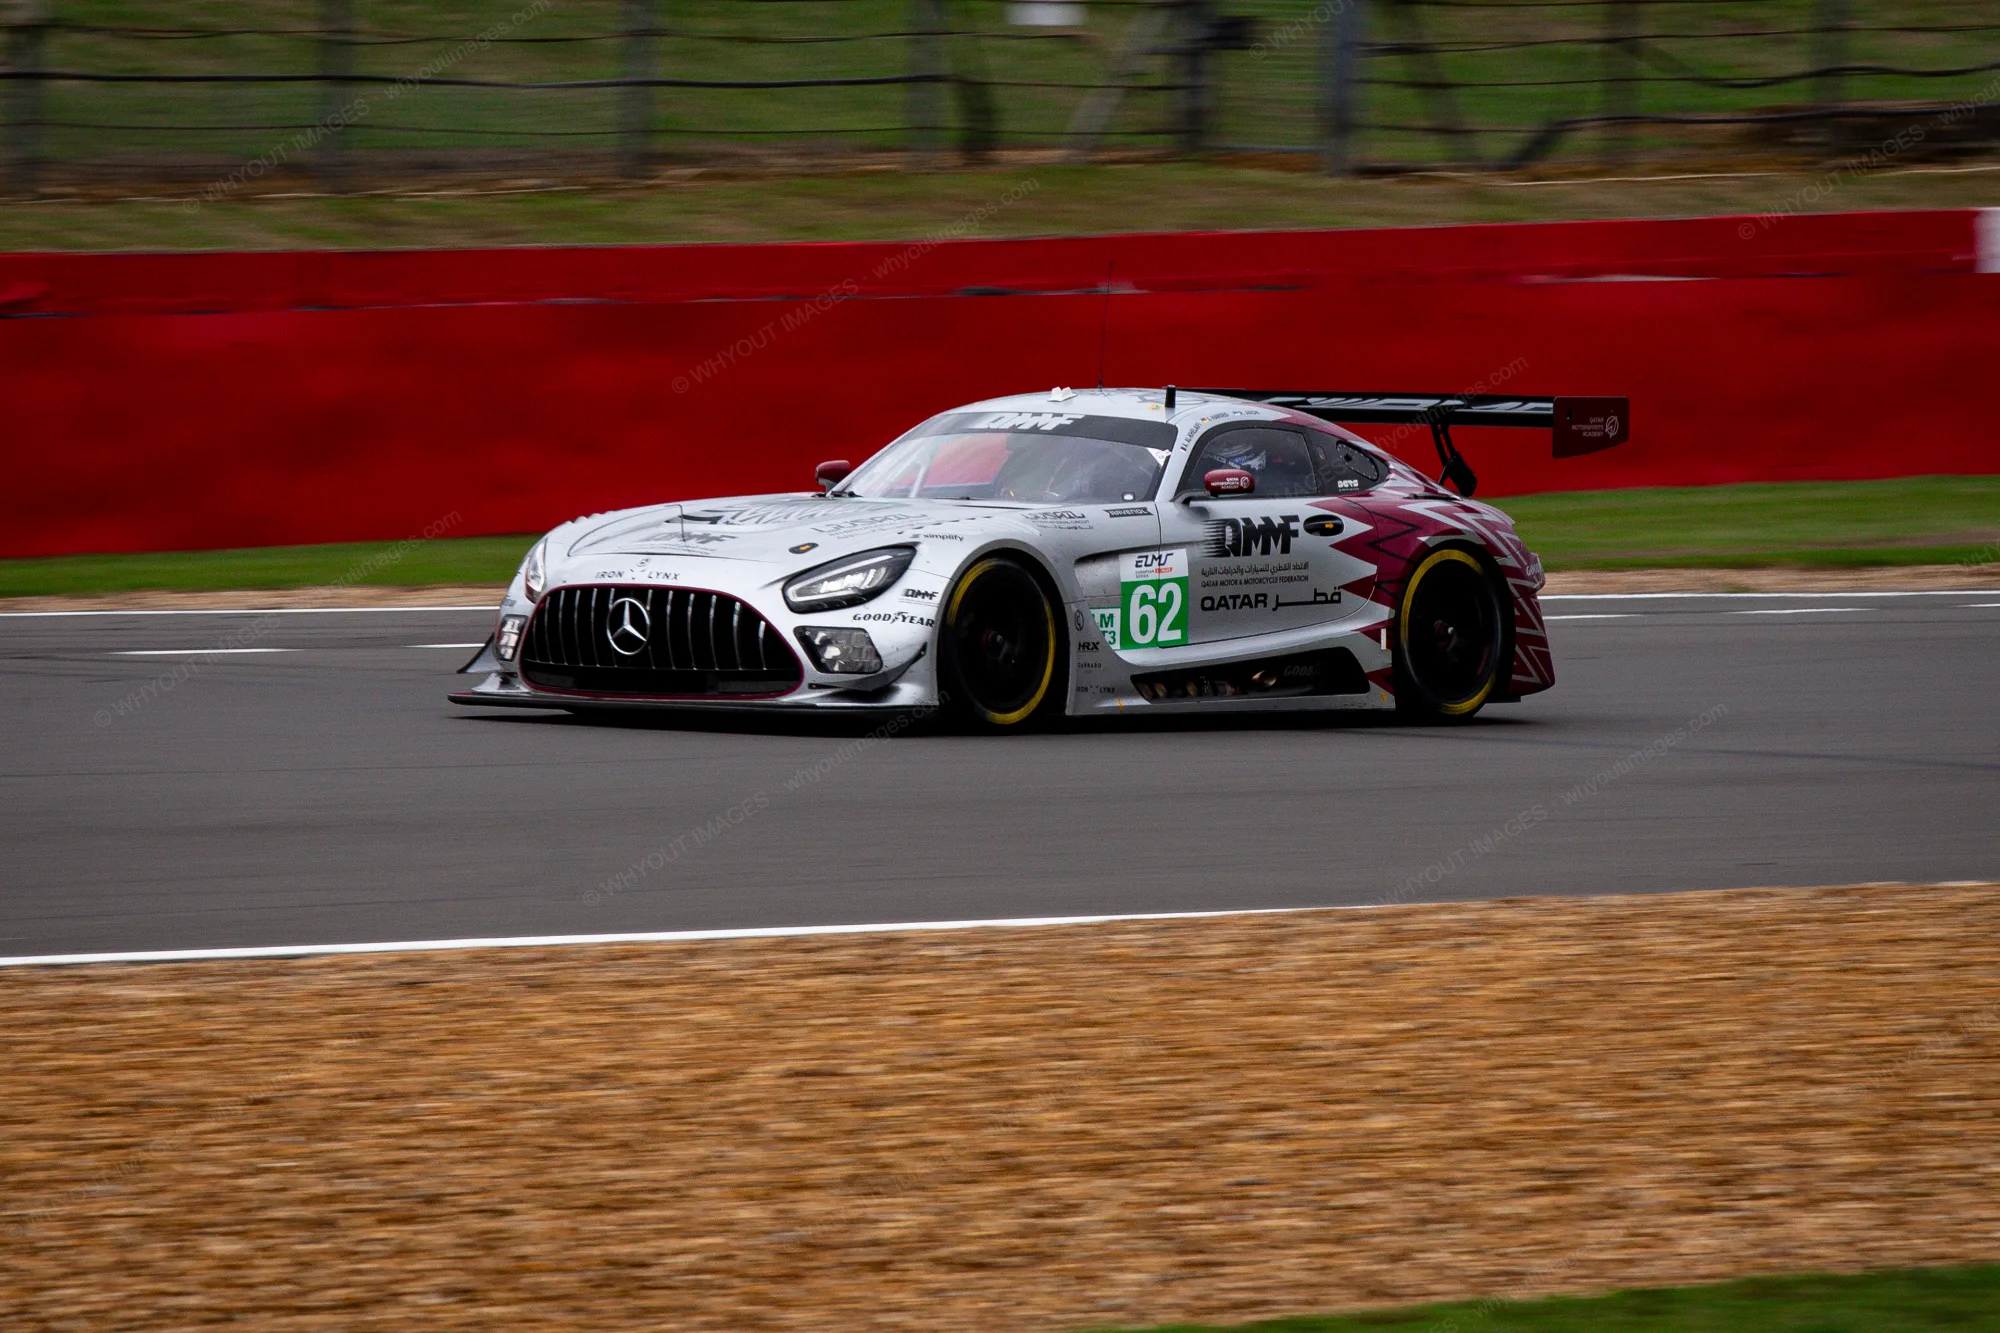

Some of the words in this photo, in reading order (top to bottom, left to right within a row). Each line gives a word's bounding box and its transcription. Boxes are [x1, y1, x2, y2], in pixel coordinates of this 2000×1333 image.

[1109, 508, 1148, 518] RAVENOL
[923, 533, 964, 543] simplify
[1202, 515, 1300, 558] QMMF
[1135, 552, 1174, 568] ELMS
[595, 570, 625, 579] IRON
[647, 571, 680, 581] LYNX
[1201, 580, 1218, 588] QATAR
[1219, 579, 1238, 587] MOTOR
[1243, 577, 1278, 586] MOTORCYCLE
[1279, 574, 1309, 584] FEDERATION
[1200, 593, 1268, 611] QATAR
[1272, 586, 1342, 612] قطر
[852, 611, 935, 628] GOODYEAR
[1129, 582, 1183, 645] 62
[1077, 641, 1100, 651] HRX
